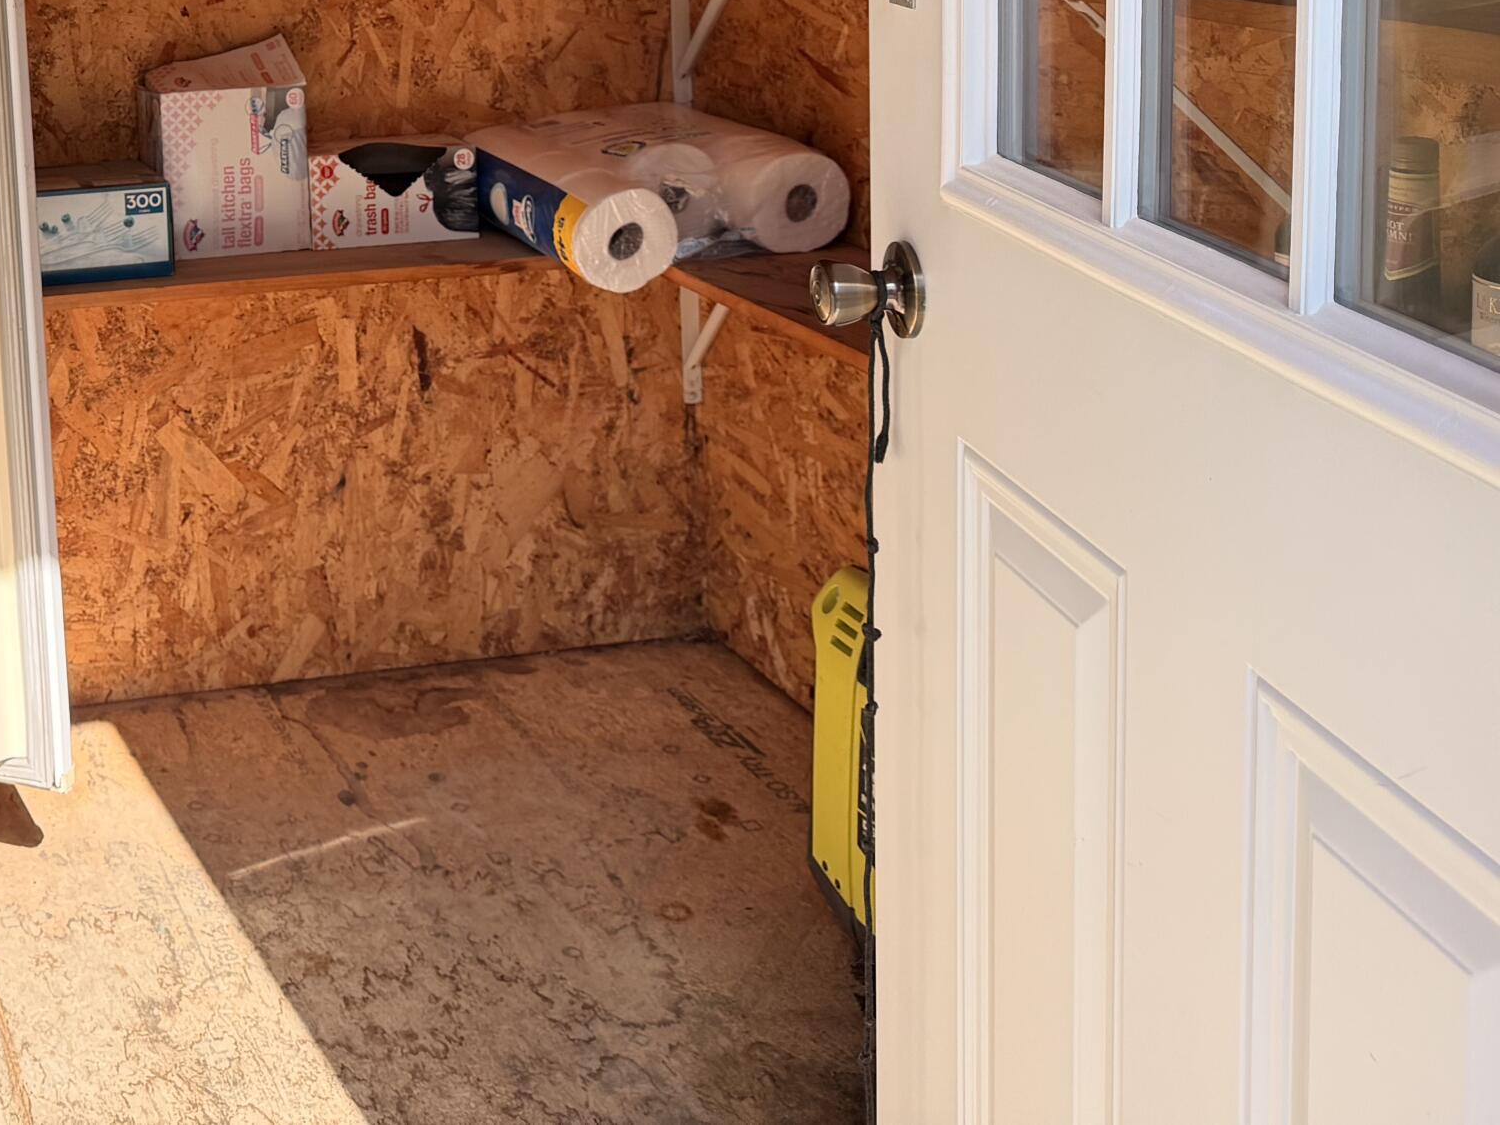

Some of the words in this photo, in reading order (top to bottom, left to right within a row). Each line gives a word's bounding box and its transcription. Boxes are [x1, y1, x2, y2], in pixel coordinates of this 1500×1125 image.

[288, 92, 299, 106] 60
[457, 153, 467, 165] 28
[238, 157, 254, 195] bags
[126, 192, 162, 210] 300
[220, 165, 236, 222] kitchen
[237, 201, 252, 249] flextra
[364, 203, 377, 236] trash
[220, 227, 236, 250] tall
